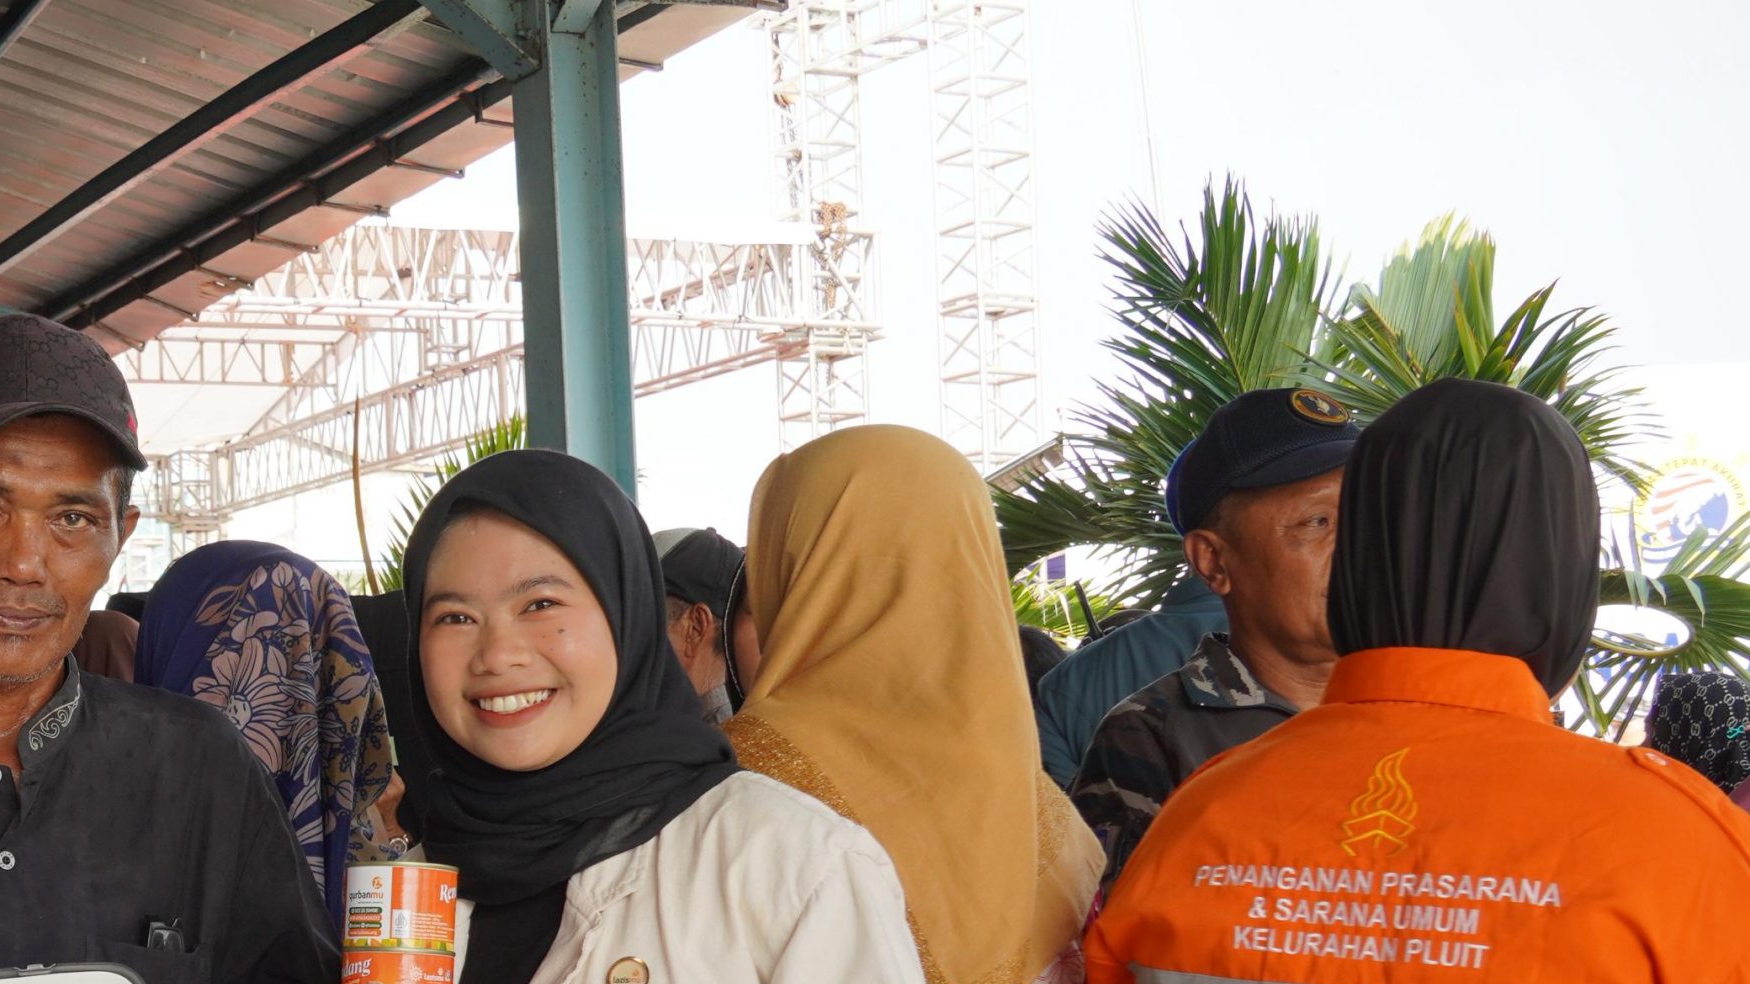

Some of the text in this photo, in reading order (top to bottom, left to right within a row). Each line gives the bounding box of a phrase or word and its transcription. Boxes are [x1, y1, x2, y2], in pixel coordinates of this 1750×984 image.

[1195, 864, 1562, 907] PENANGANAN PRASARANA
[1248, 896, 1481, 935] & SARANA UMUM
[1233, 925, 1490, 970] KELURAHAN PLUIT
